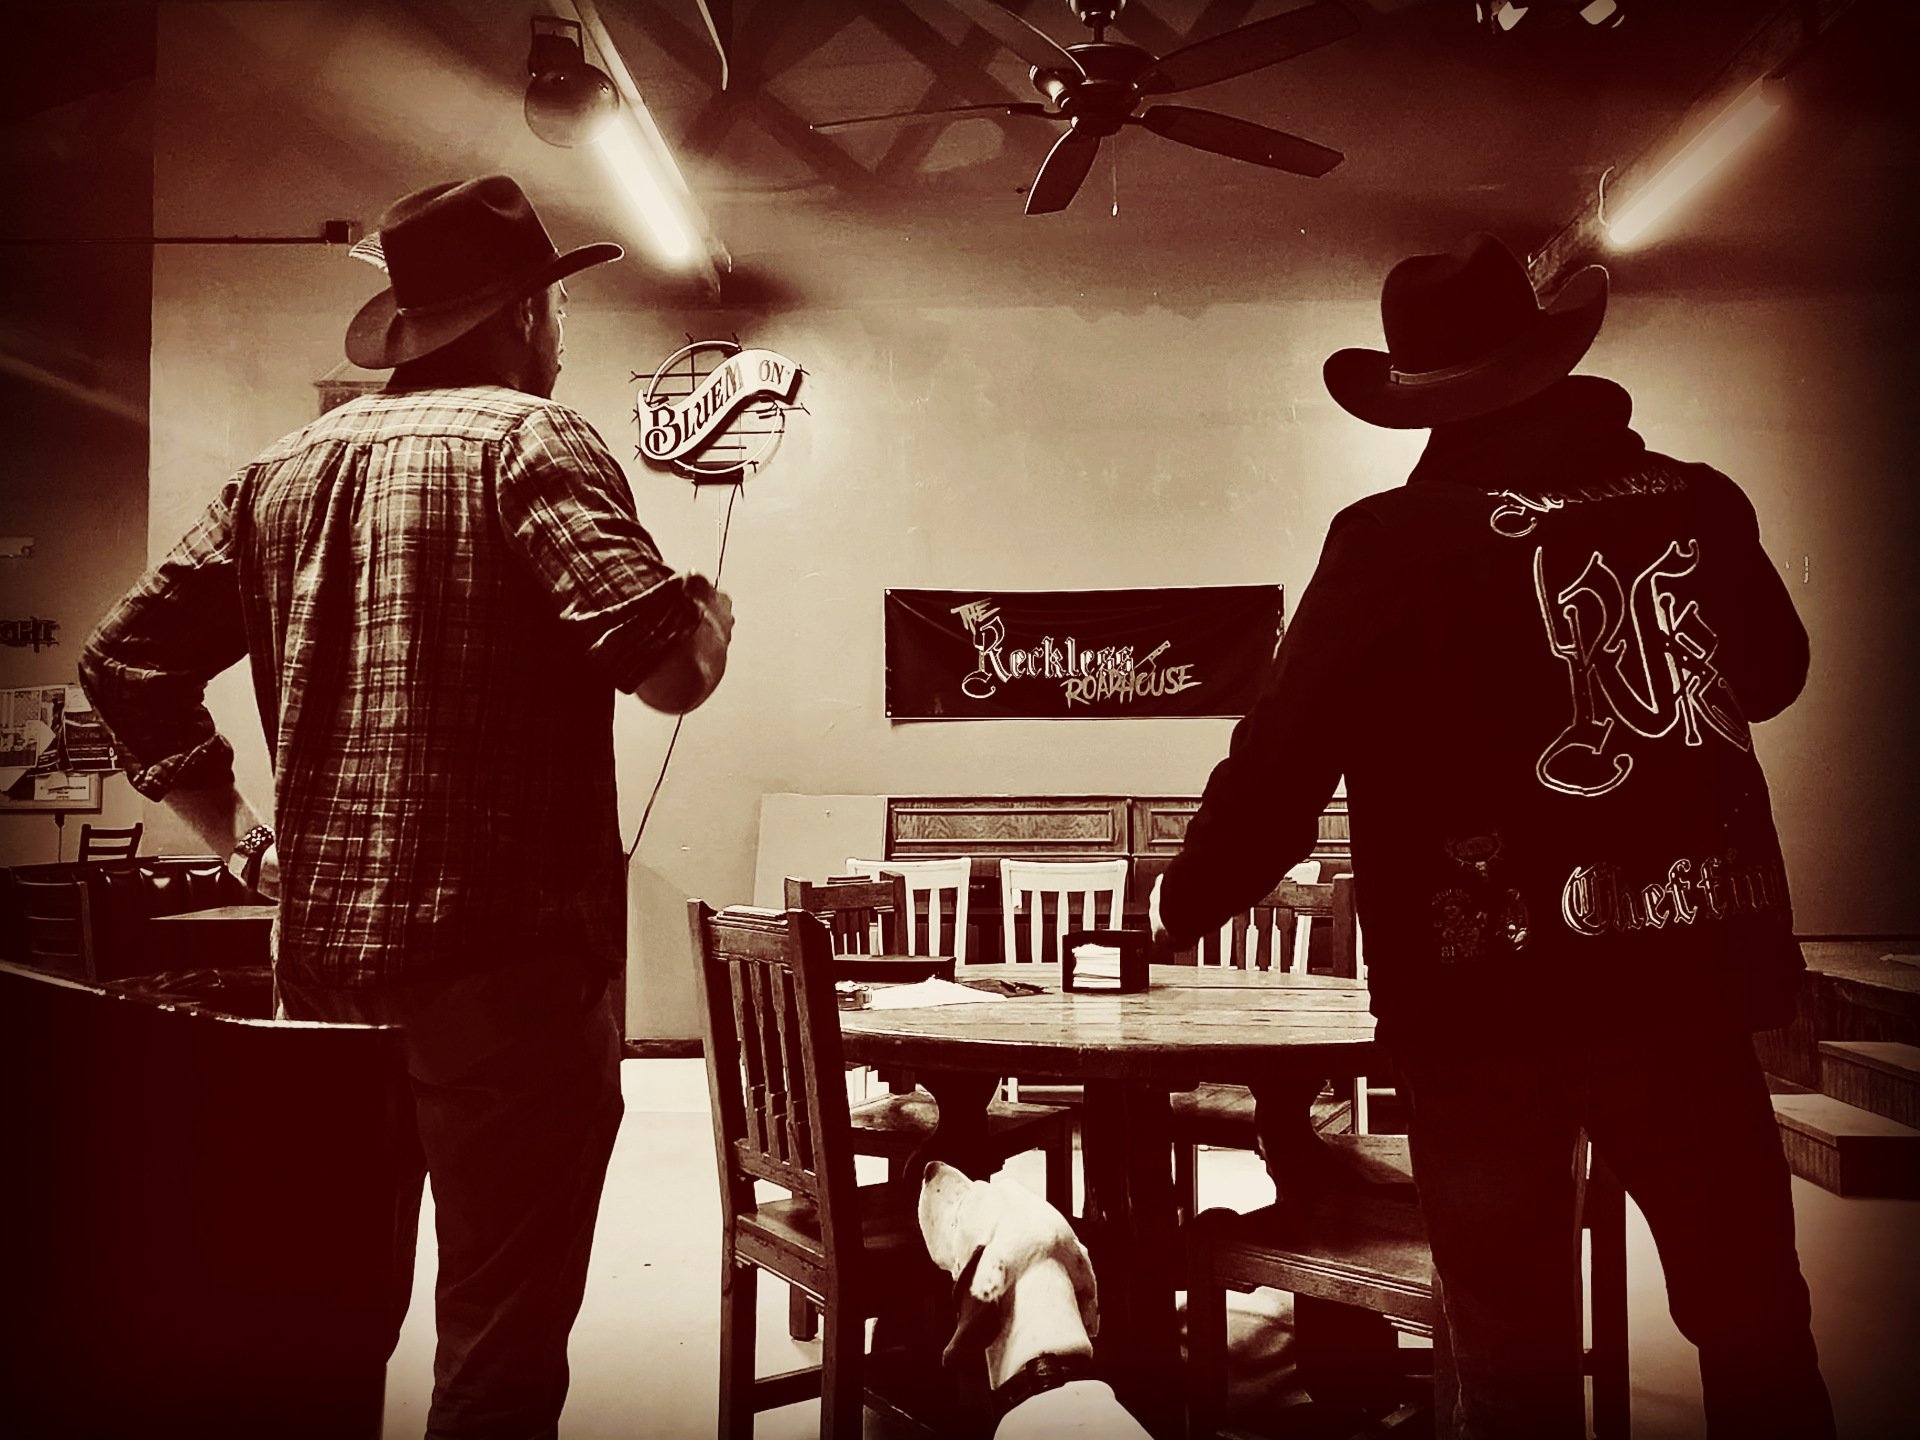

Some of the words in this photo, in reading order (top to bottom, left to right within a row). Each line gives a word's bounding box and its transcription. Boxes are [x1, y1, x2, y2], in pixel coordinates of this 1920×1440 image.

[949, 597, 1001, 633] THE
[961, 615, 1135, 699] Reckless
[1059, 662, 1203, 709] ROADHOUSE
